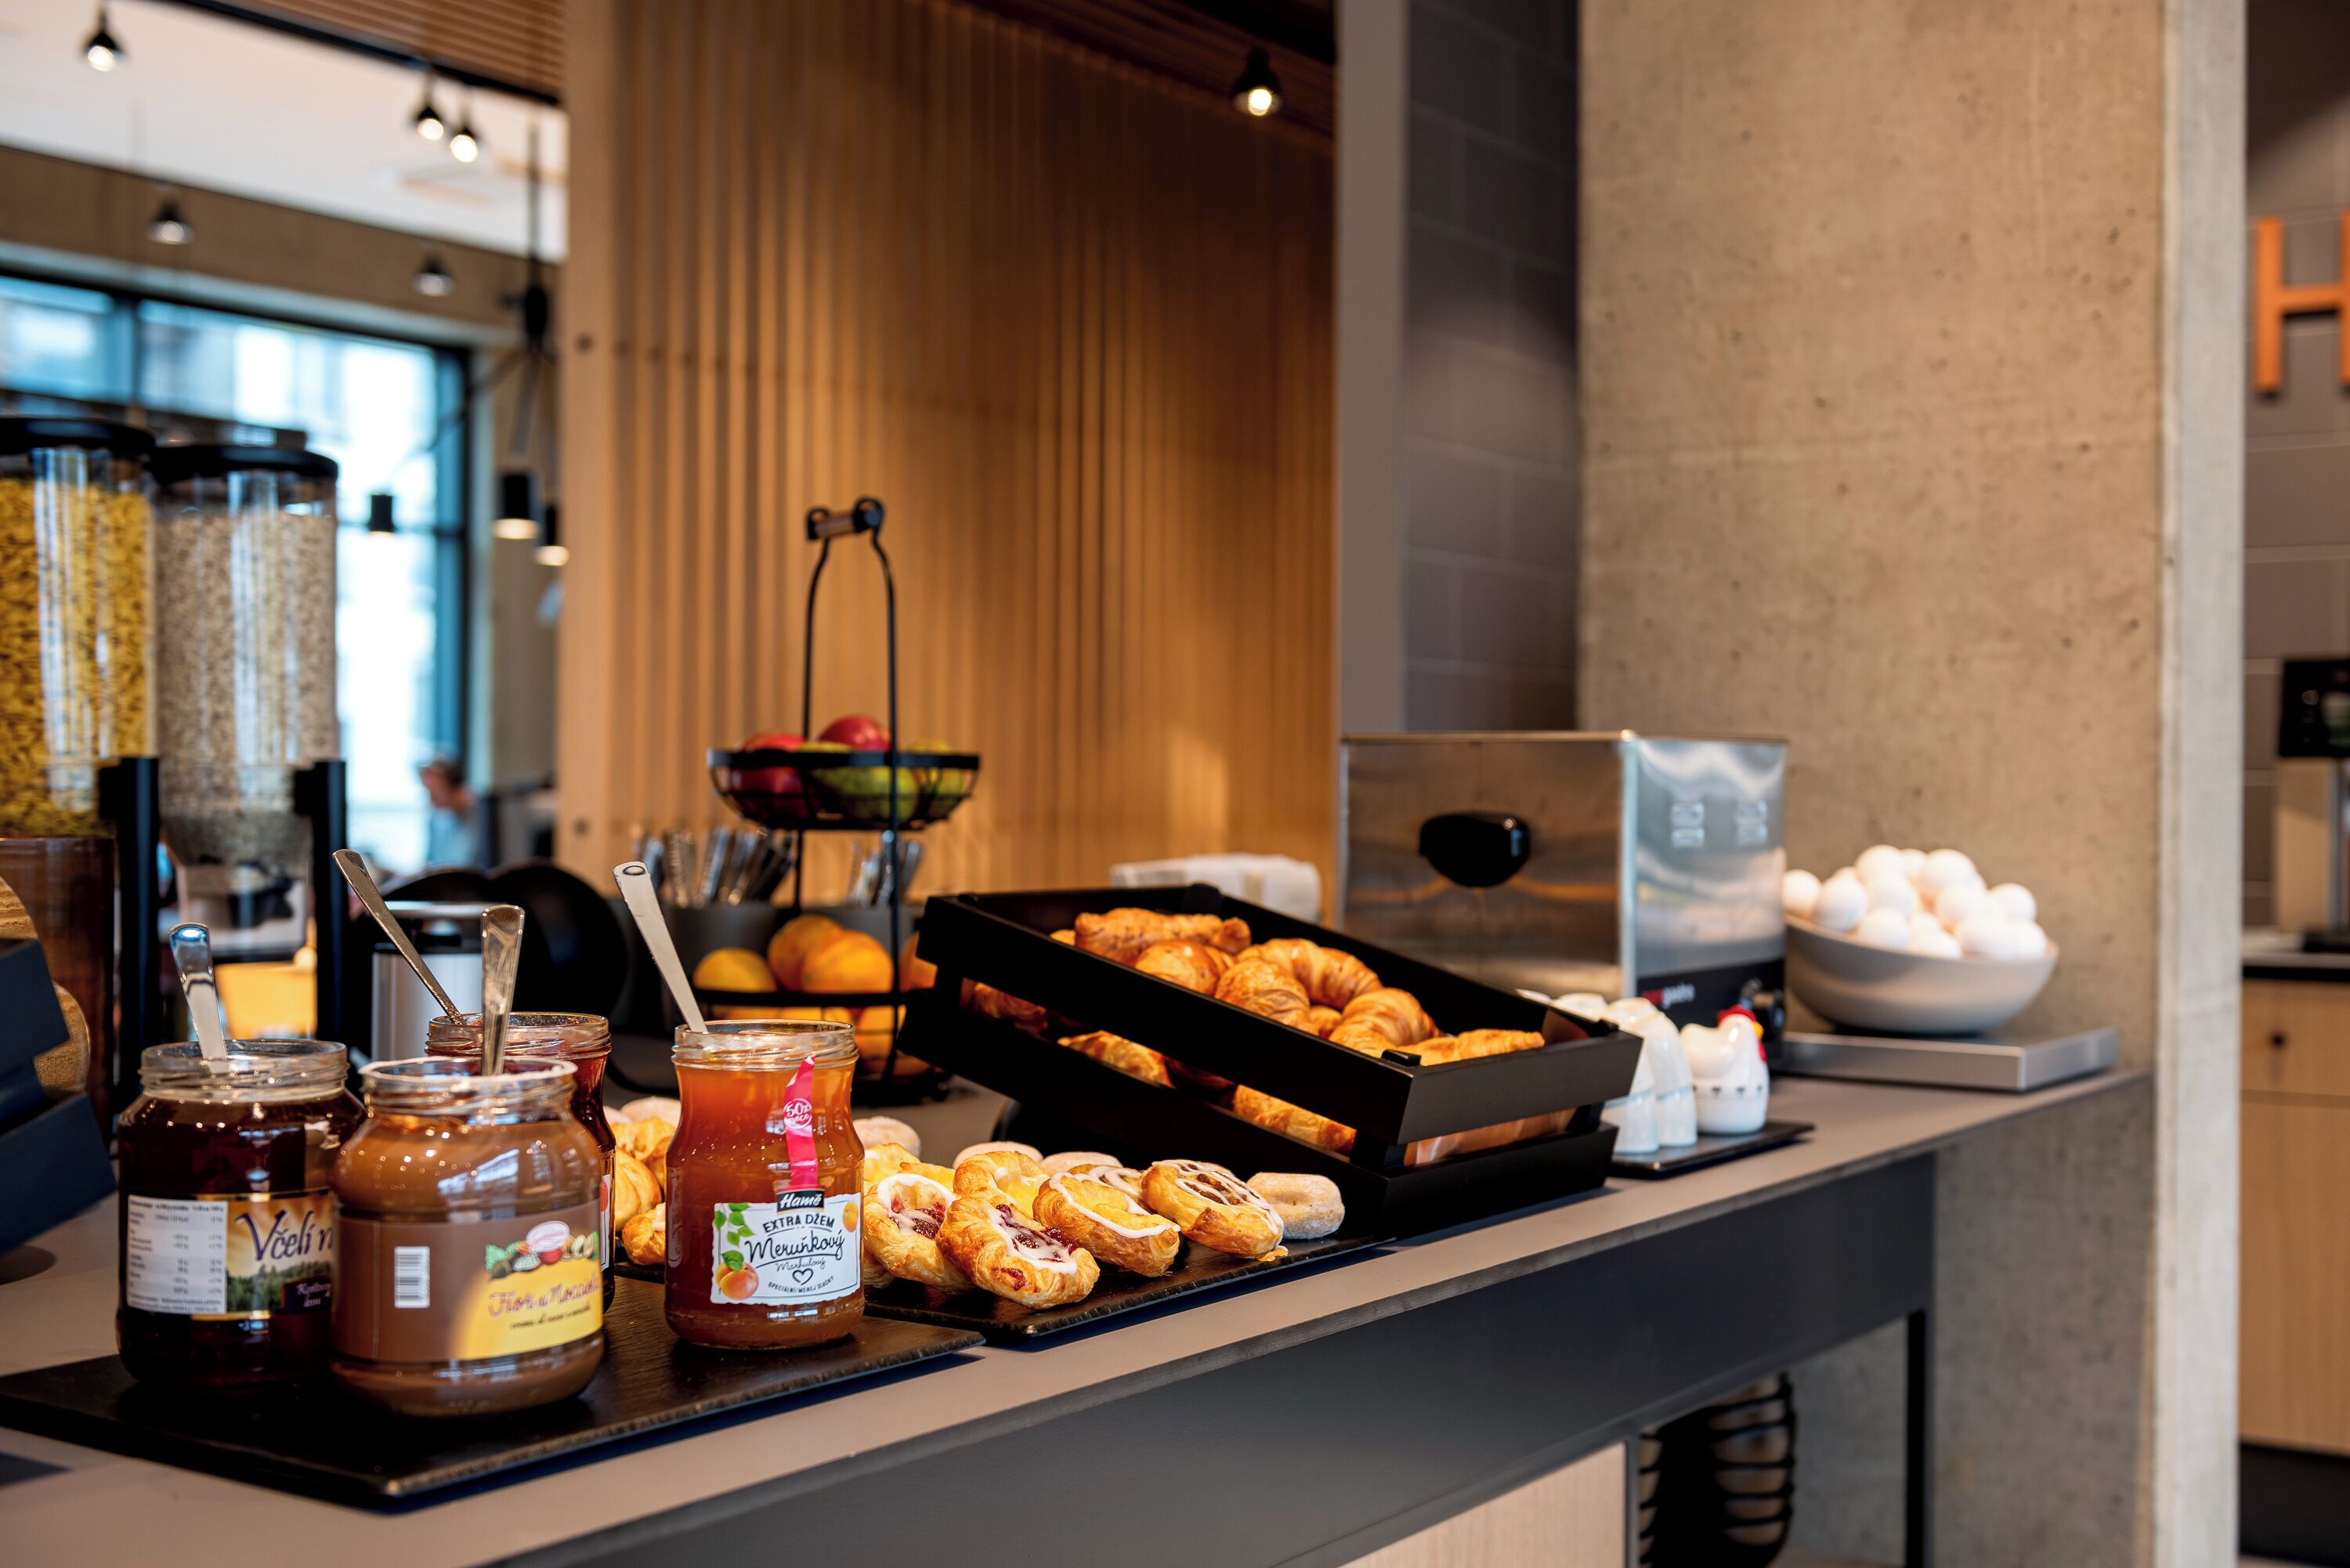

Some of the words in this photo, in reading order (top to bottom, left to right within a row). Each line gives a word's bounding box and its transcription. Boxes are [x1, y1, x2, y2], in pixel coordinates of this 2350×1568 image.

[234, 1209, 315, 1261] Včelí
[763, 1215, 801, 1233] EXTRA
[805, 1212, 835, 1228] DŽEM
